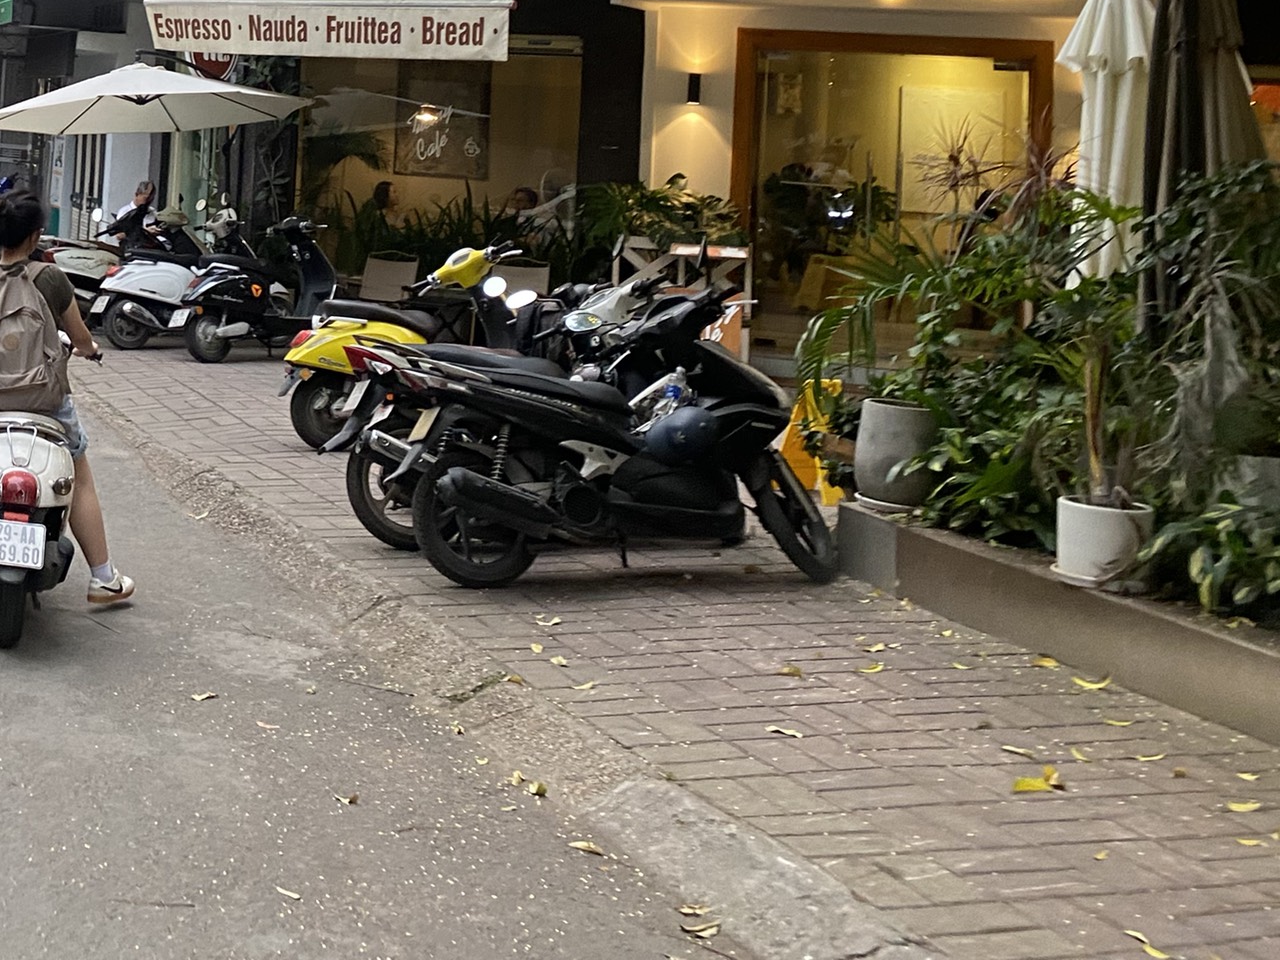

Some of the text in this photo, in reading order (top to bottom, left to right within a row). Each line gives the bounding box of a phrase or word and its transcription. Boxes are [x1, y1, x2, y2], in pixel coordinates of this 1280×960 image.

[153, 13, 485, 46] Espresso Nauda Fruittea Bread
